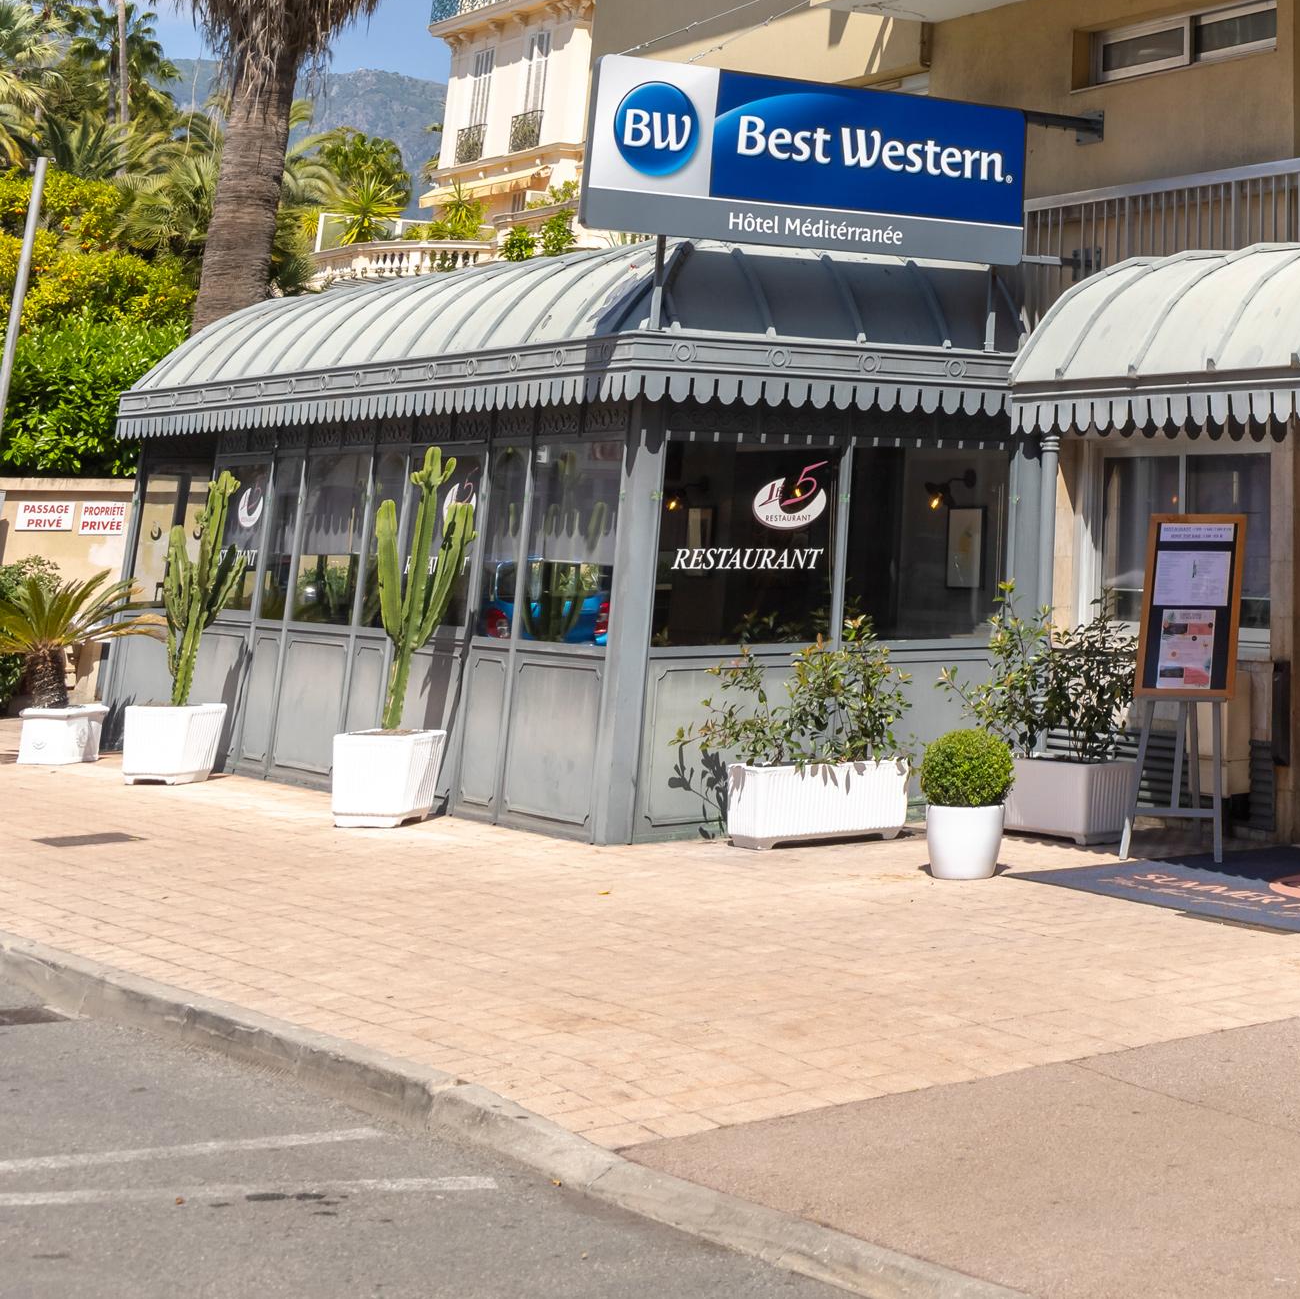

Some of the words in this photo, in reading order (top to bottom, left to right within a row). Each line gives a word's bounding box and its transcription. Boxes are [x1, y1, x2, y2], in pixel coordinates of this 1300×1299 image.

[623, 107, 691, 152] BW
[736, 114, 831, 165] Best
[728, 211, 779, 234] Hôtel
[784, 217, 903, 246] Méditérranée
[781, 461, 829, 506] 5
[23, 504, 70, 514] PASSAGE
[83, 503, 125, 516] PROPRIÉTÉ
[765, 514, 811, 522] RESTAURANT
[27, 516, 62, 528] PRIVÉ
[81, 518, 122, 531] PRIVÉE
[671, 547, 824, 570] RESTAURANT
